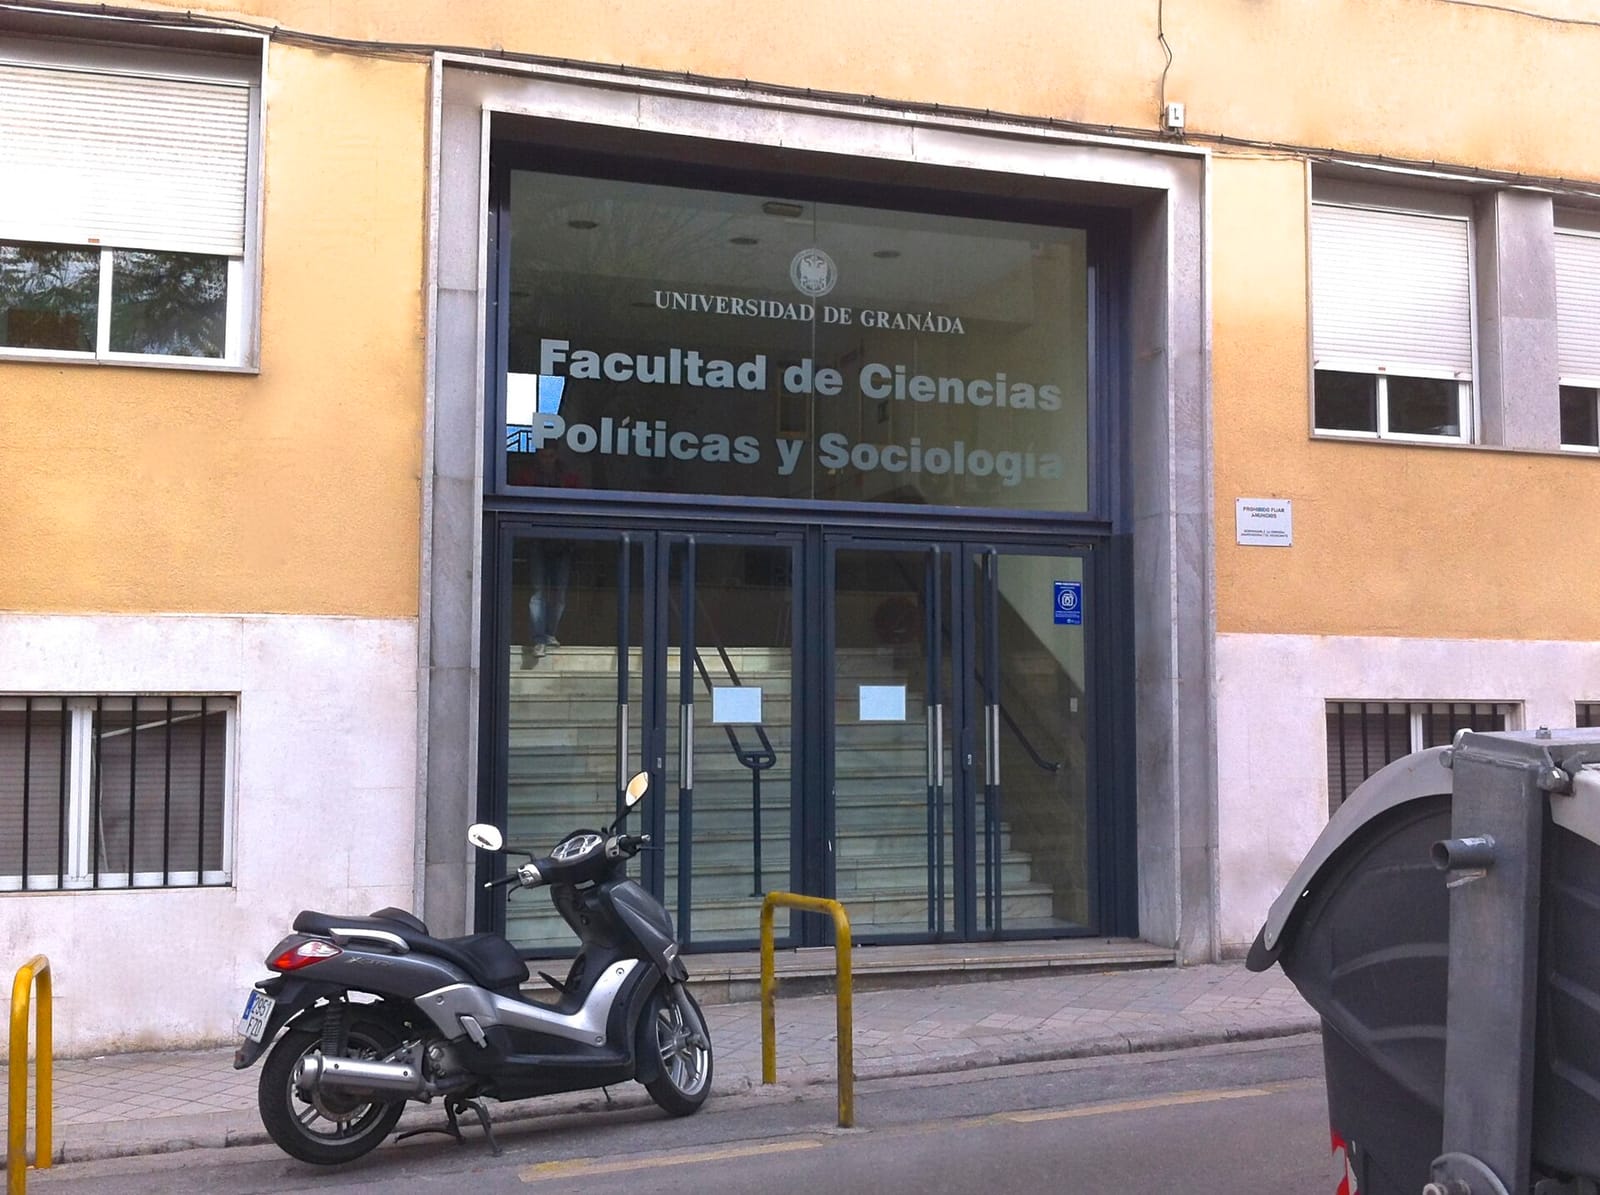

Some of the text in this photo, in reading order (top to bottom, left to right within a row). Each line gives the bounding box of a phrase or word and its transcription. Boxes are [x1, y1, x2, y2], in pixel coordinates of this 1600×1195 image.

[654, 290, 816, 322] UNIVERSIDAD
[823, 306, 853, 325] DE
[538, 338, 1064, 411] Facultad de Ciencias
[531, 411, 1065, 487] Políticas y Sociología
